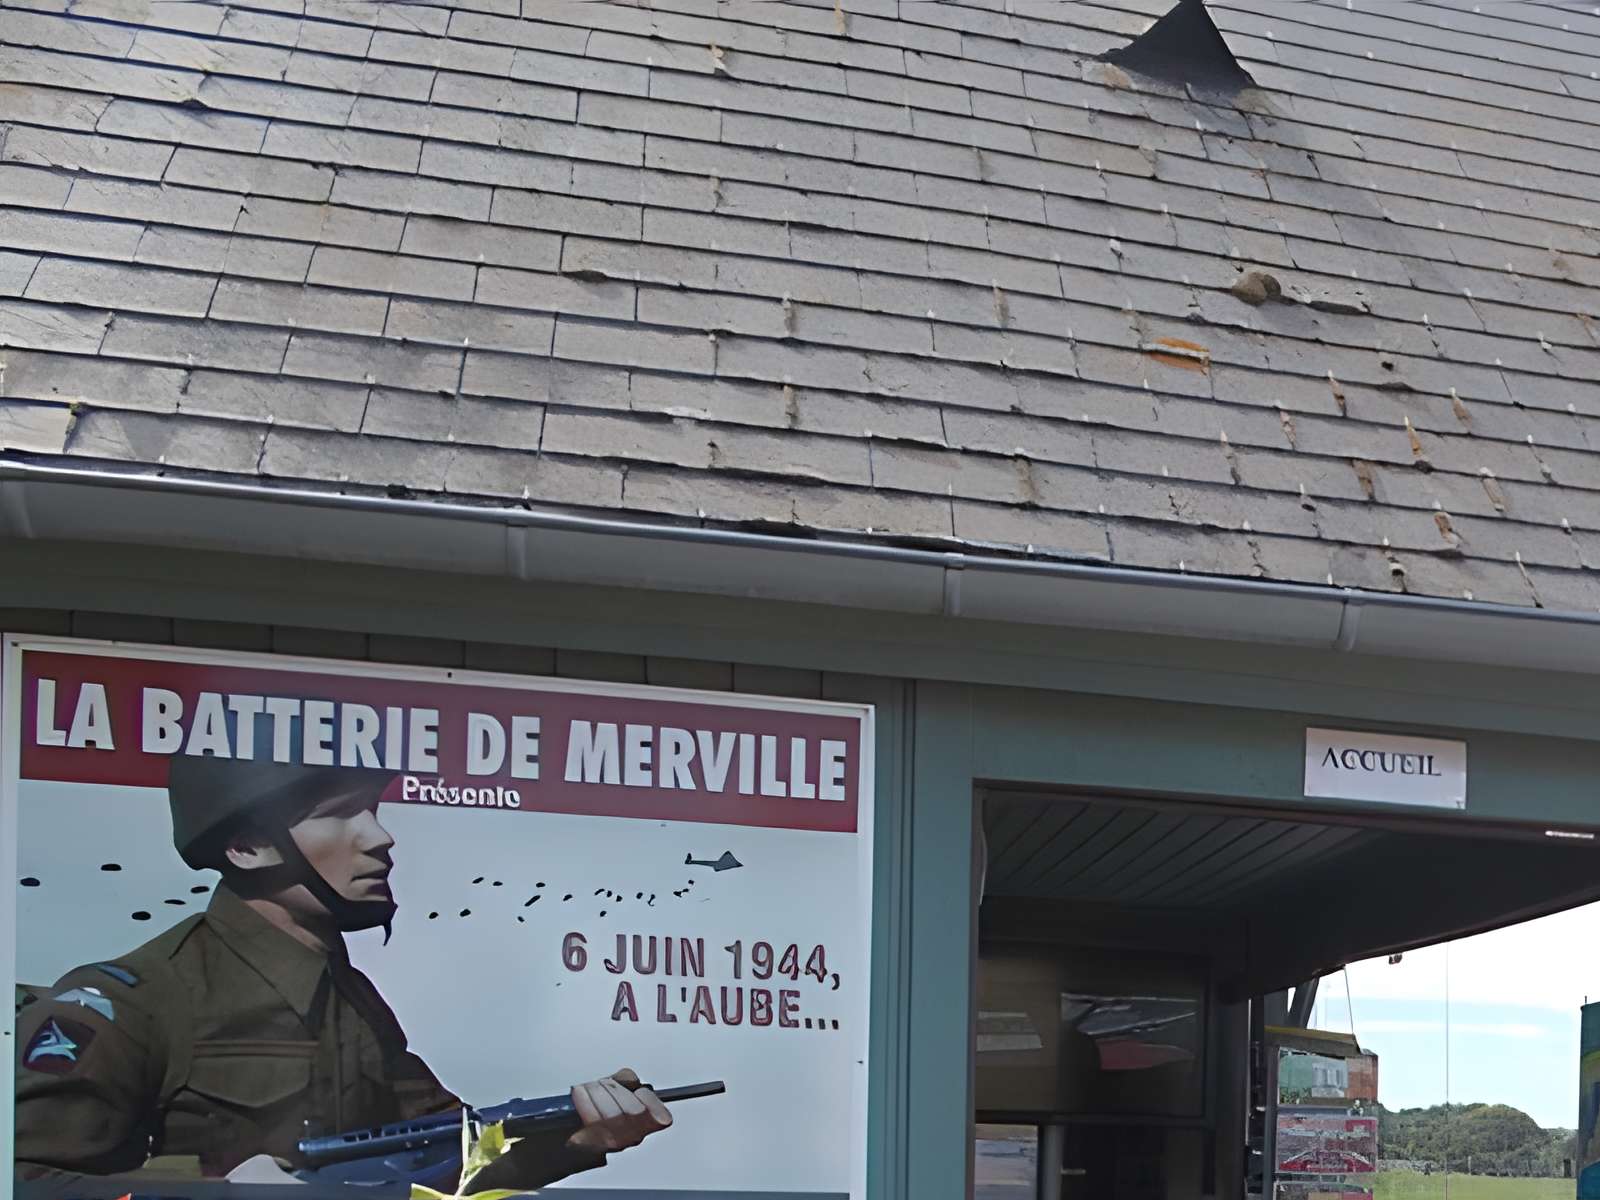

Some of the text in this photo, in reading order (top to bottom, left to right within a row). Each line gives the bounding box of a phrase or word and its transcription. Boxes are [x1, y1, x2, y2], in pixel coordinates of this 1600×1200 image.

[36, 678, 847, 801] LA BATTERIE DE MERVILLE
[1322, 748, 1442, 776] ACCUEIL
[562, 931, 840, 990] 6 JUIN 1944,
[611, 981, 840, 1030] A L'AUBE...
